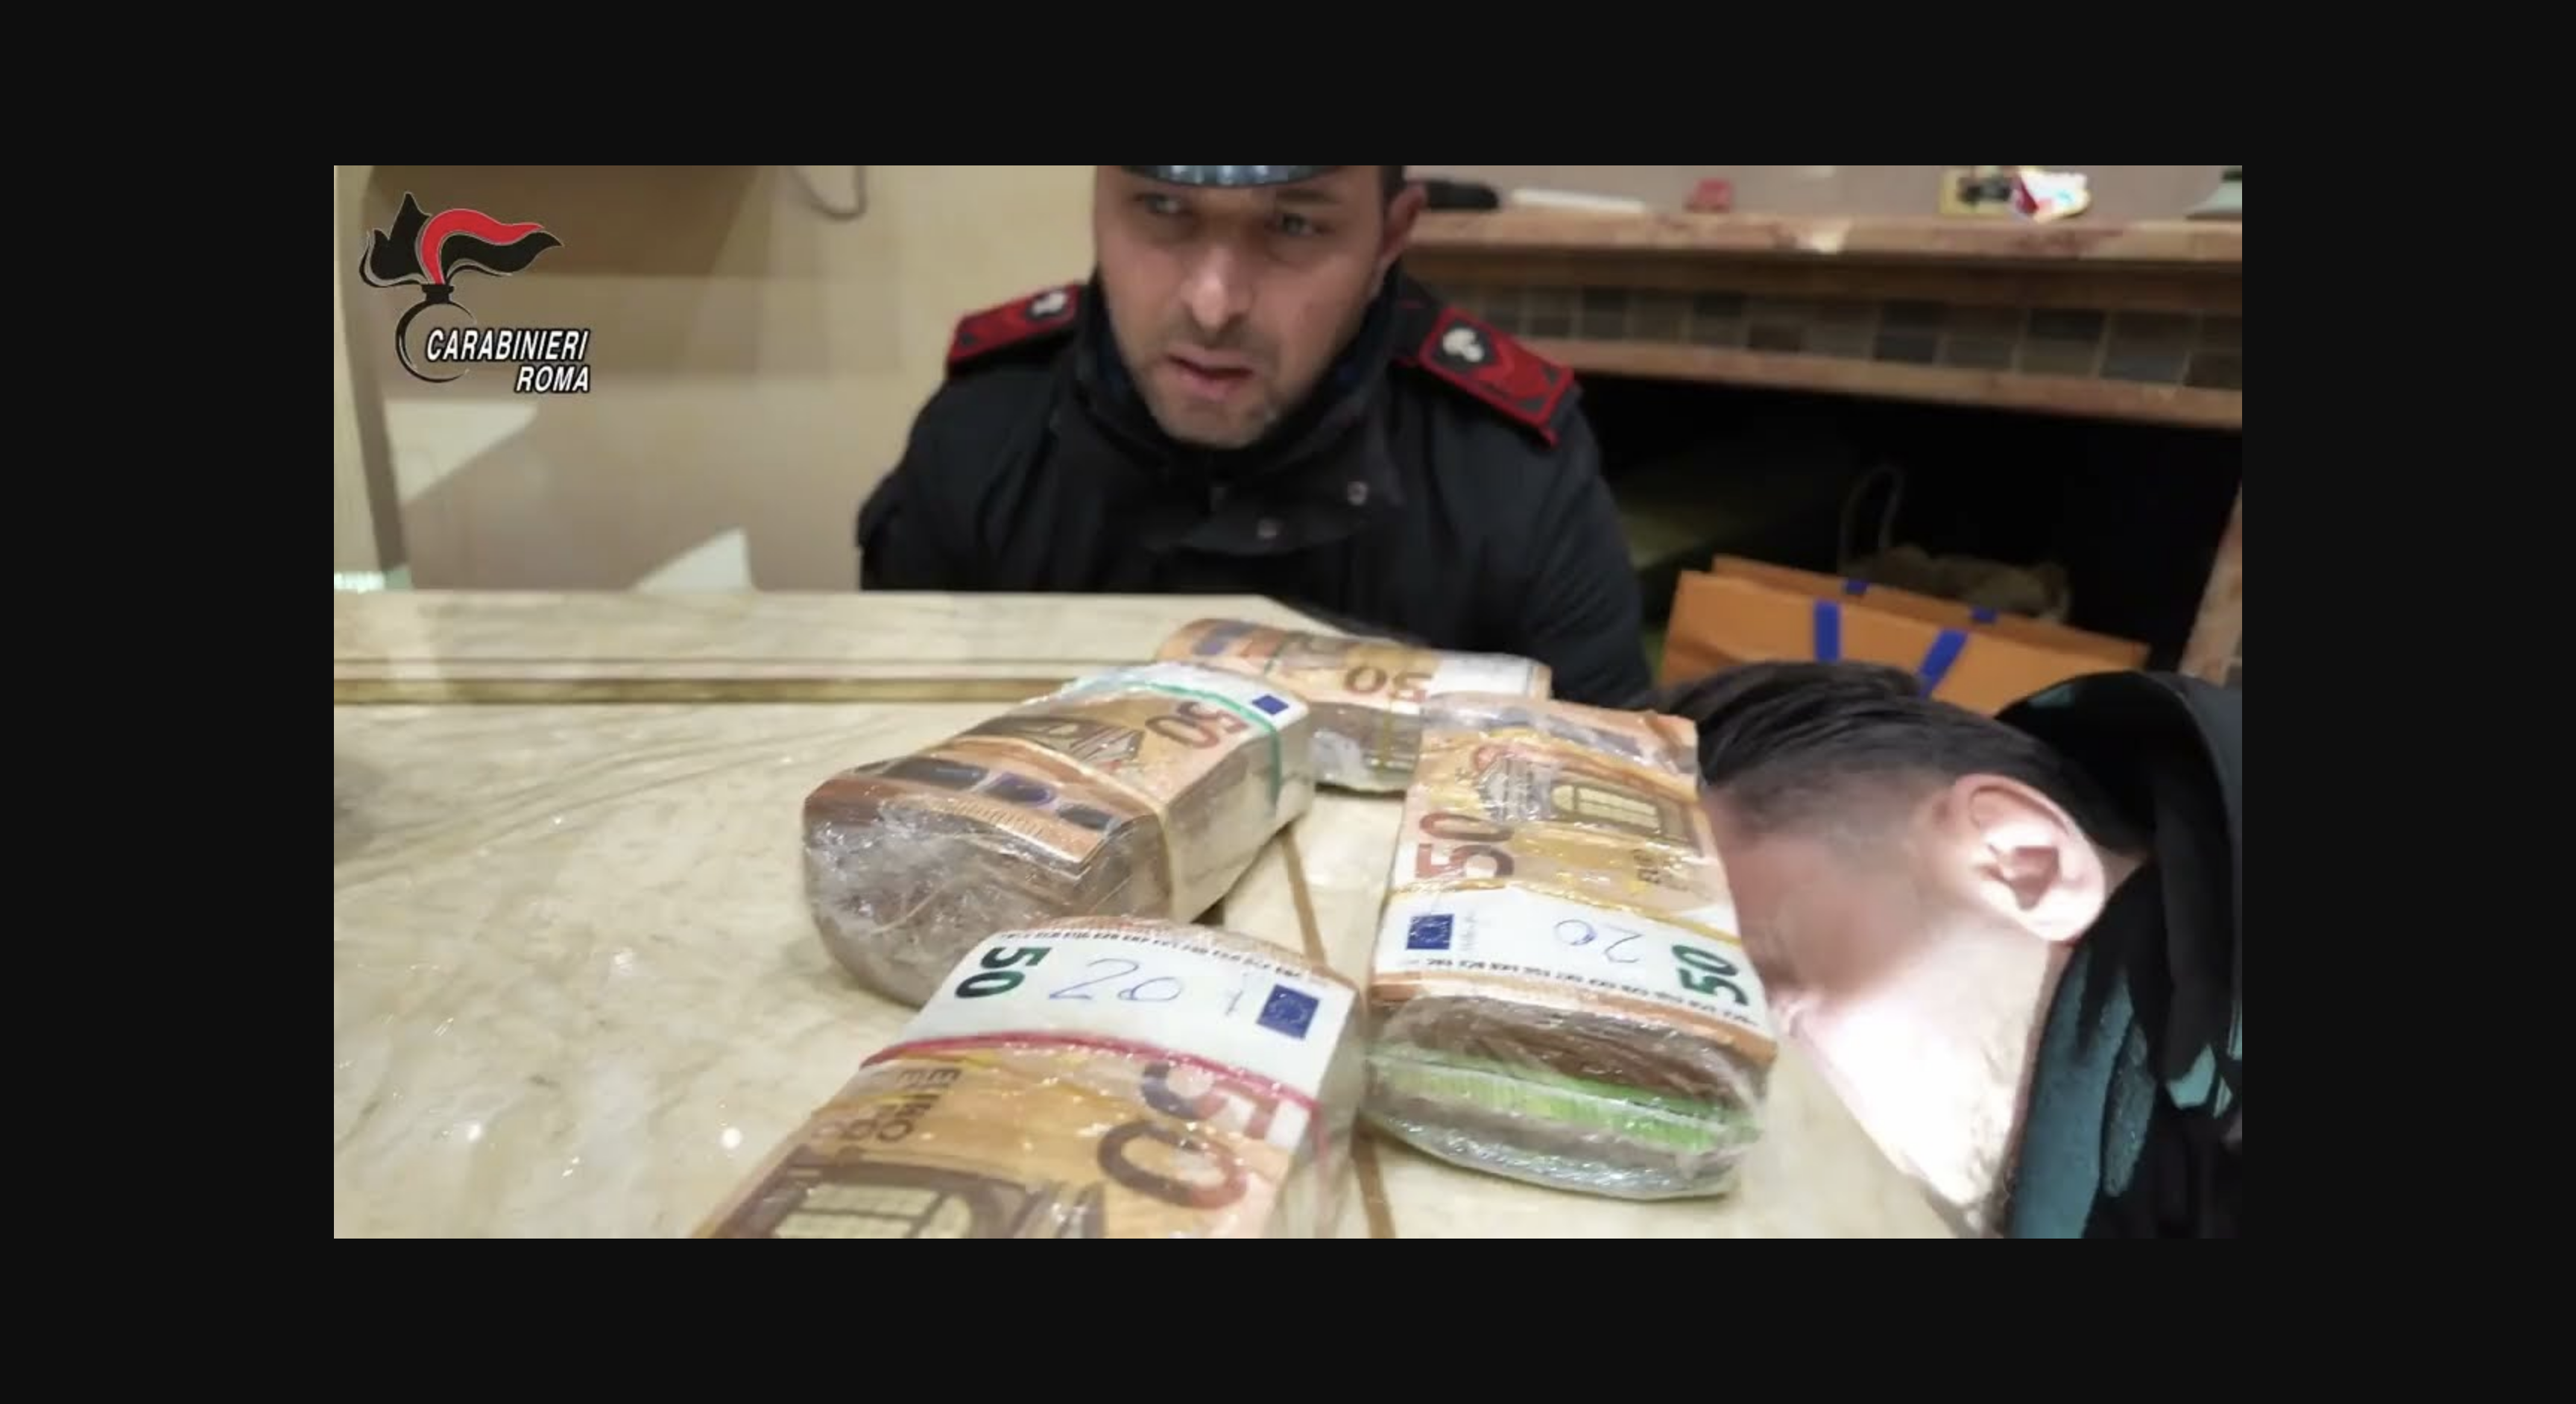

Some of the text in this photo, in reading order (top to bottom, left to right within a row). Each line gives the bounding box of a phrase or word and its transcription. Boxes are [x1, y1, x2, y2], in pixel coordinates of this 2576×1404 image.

[1146, 701, 1249, 749] 50
[1415, 811, 1515, 879] 50
[955, 946, 1052, 999] 50
[1048, 957, 1184, 1002] 20
[1671, 943, 1749, 1006] 50
[1096, 1061, 1281, 1209] 50
